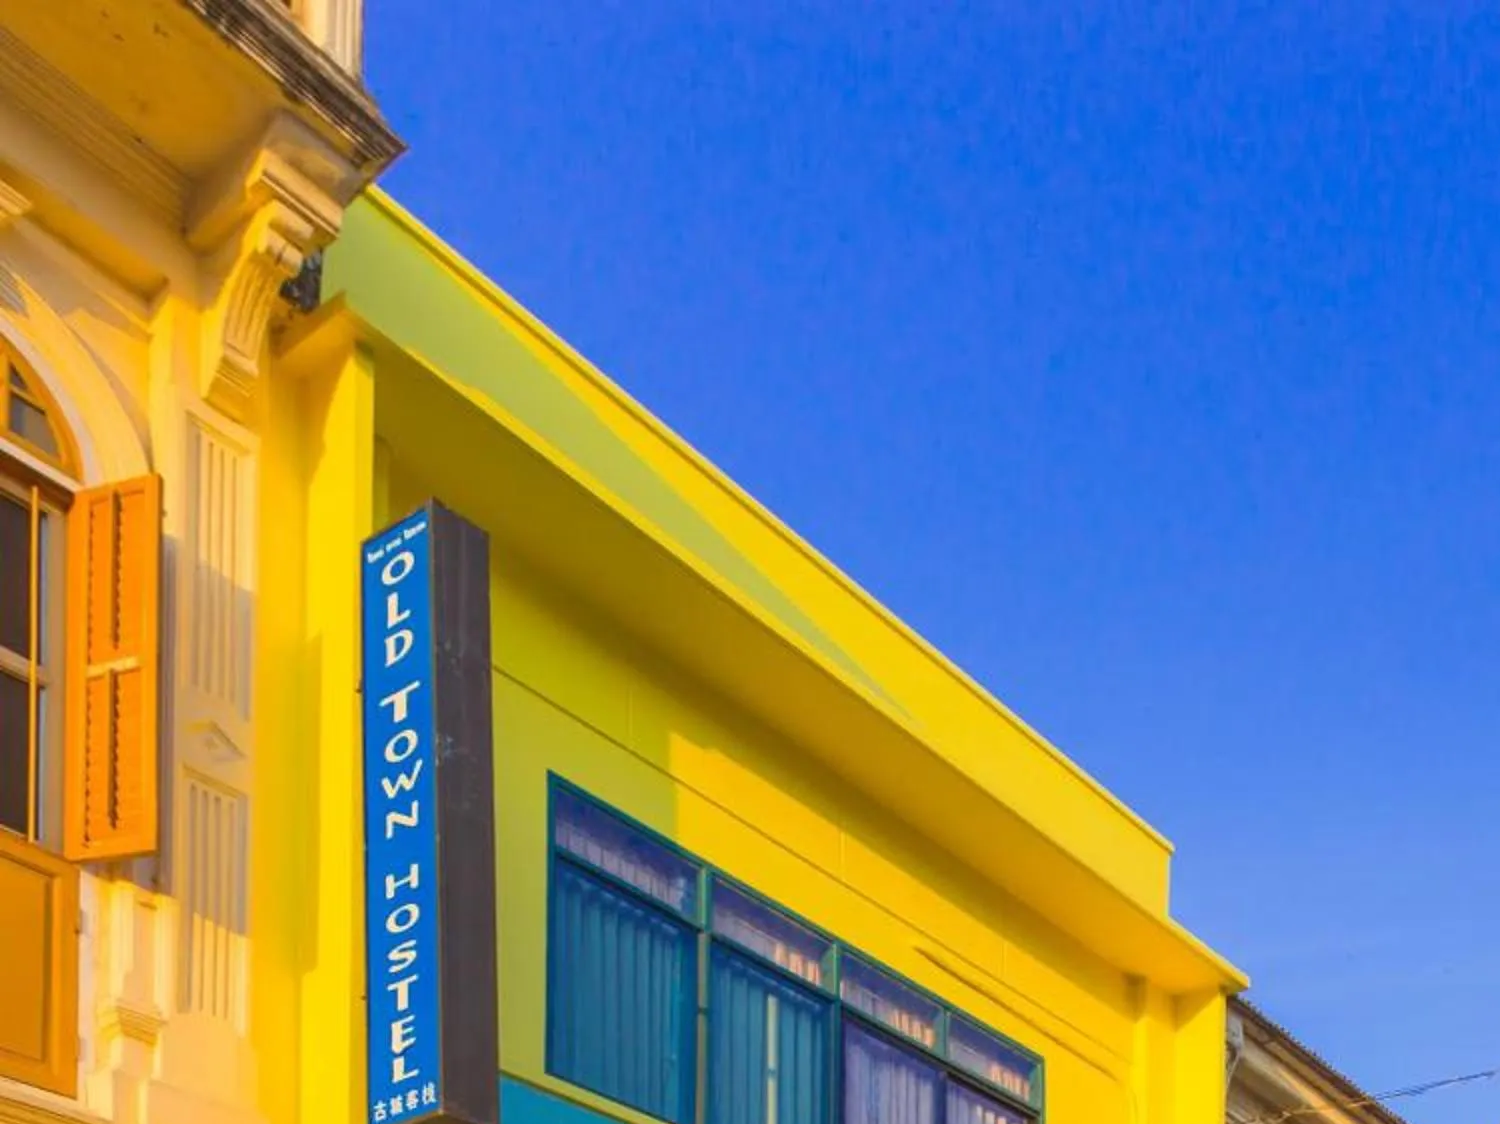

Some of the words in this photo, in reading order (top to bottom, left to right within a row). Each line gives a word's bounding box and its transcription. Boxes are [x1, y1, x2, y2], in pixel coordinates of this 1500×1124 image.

[381, 551, 415, 668] OLD
[379, 680, 423, 839] TOWN
[385, 863, 420, 1083] HOSTEL
